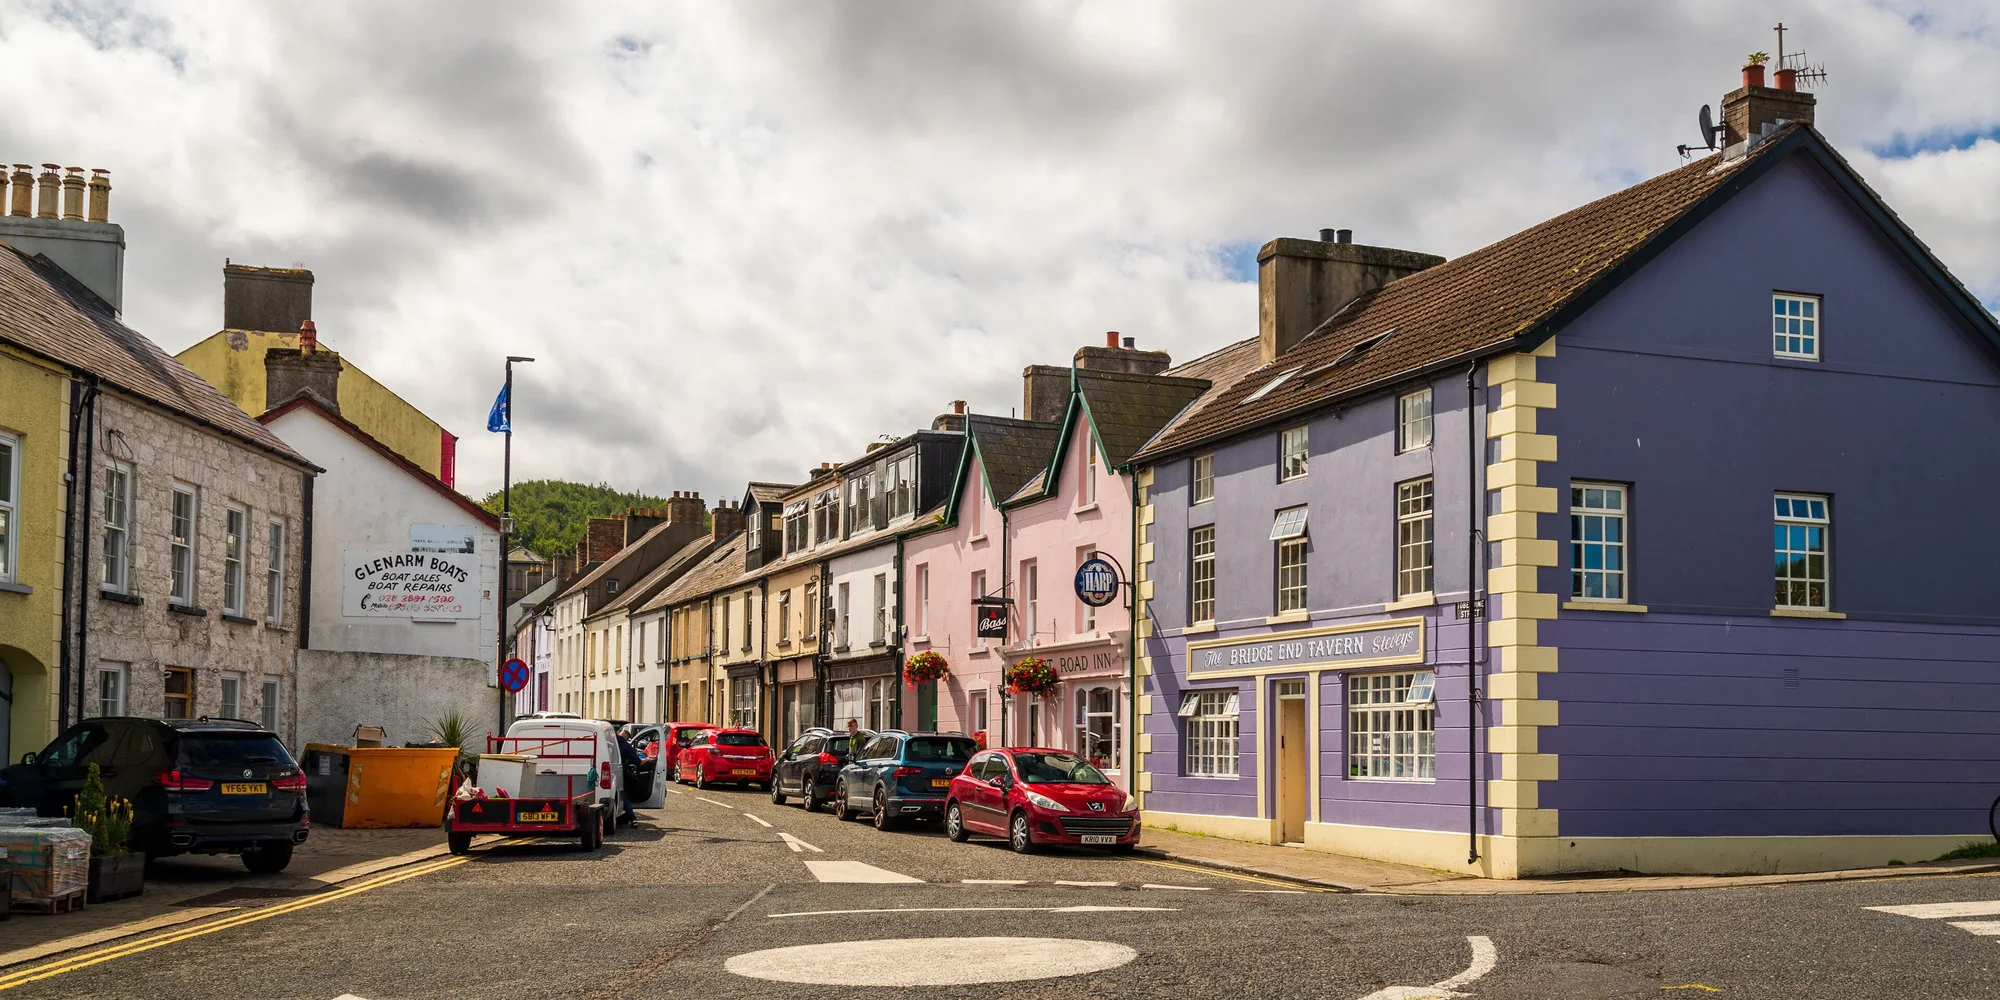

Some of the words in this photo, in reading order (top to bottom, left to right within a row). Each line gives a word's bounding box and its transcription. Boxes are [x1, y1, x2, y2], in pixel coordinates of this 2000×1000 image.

[355, 554, 425, 580] GLENARM
[430, 557, 468, 583] BOATS
[381, 572, 411, 582] BOAT
[412, 573, 441, 583] SALES
[1084, 572, 1112, 592] HARP
[367, 581, 399, 591] BOAT
[403, 583, 453, 593] REPAIRS
[979, 616, 1007, 632] Bass
[1203, 650, 1223, 669] The
[1229, 644, 1273, 666] BRIDGE
[1278, 642, 1303, 661] END
[1308, 635, 1364, 658] TAVERN
[1060, 655, 1089, 673] ROAD
[1093, 652, 1112, 670] INN
[225, 784, 247, 793] YF65
[249, 784, 264, 793] YKT
[522, 812, 540, 821] SB13
[1085, 835, 1099, 844] KR10
[1101, 835, 1113, 844] VVX
